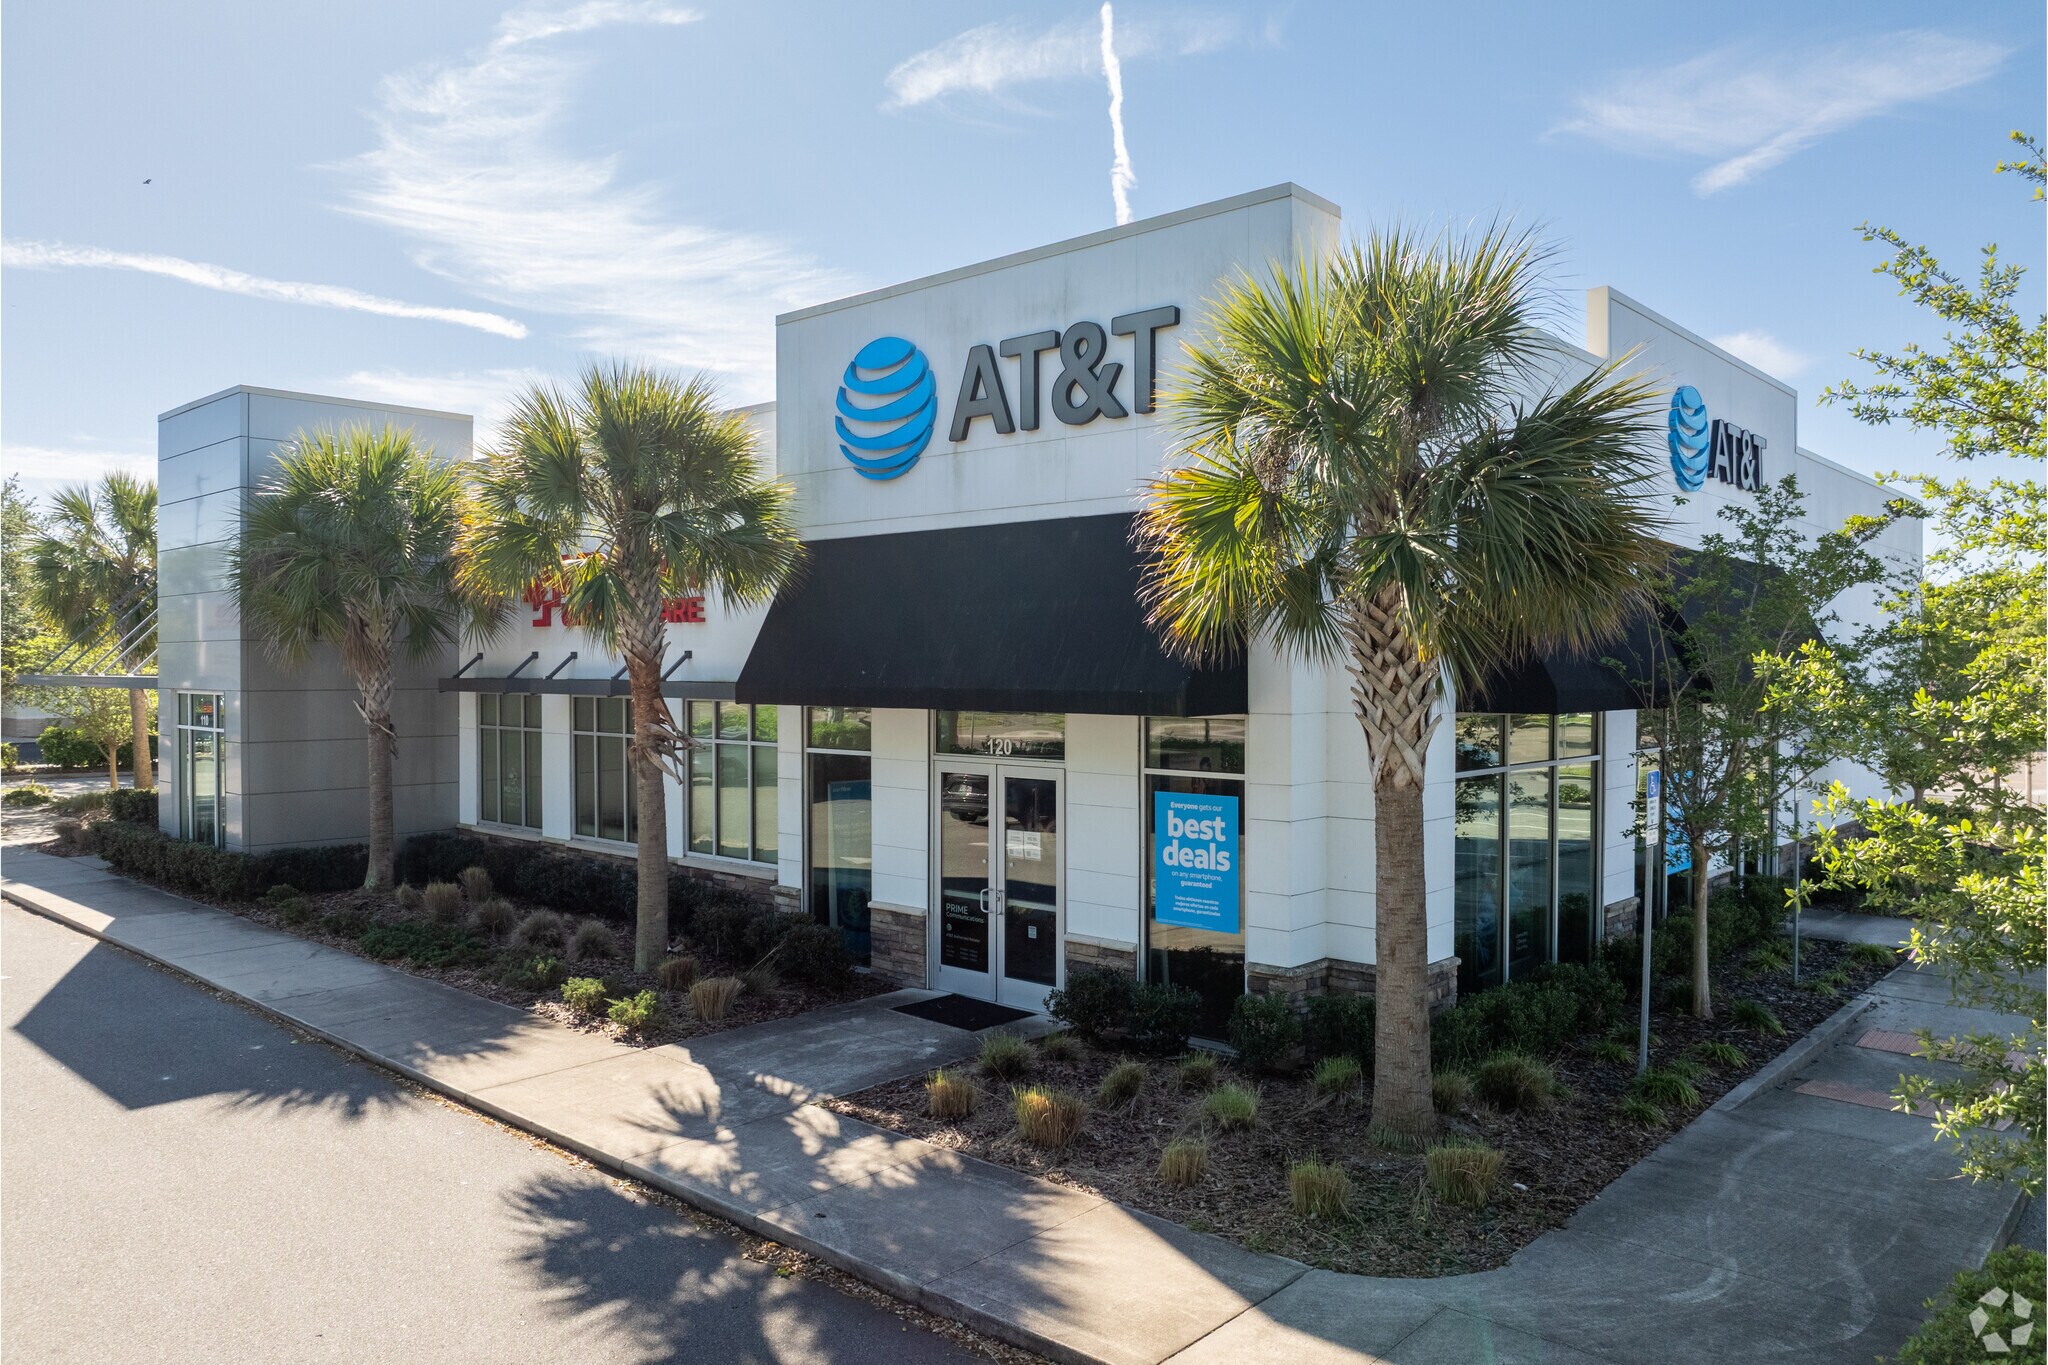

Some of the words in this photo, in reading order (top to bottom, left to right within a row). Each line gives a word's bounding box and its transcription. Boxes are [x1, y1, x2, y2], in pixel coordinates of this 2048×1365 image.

[949, 304, 1180, 442] AT&T
[1707, 419, 1767, 493] AT&T
[987, 739, 1012, 755] 120
[1170, 801, 1198, 810] Everyone
[1199, 804, 1212, 812] gets
[1168, 810, 1226, 841] best
[1163, 840, 1230, 871] deals
[1190, 872, 1222, 881] smartphone,
[1181, 880, 1212, 888] guaranteed
[946, 903, 968, 914] PRIME
[946, 912, 984, 923] Communications
